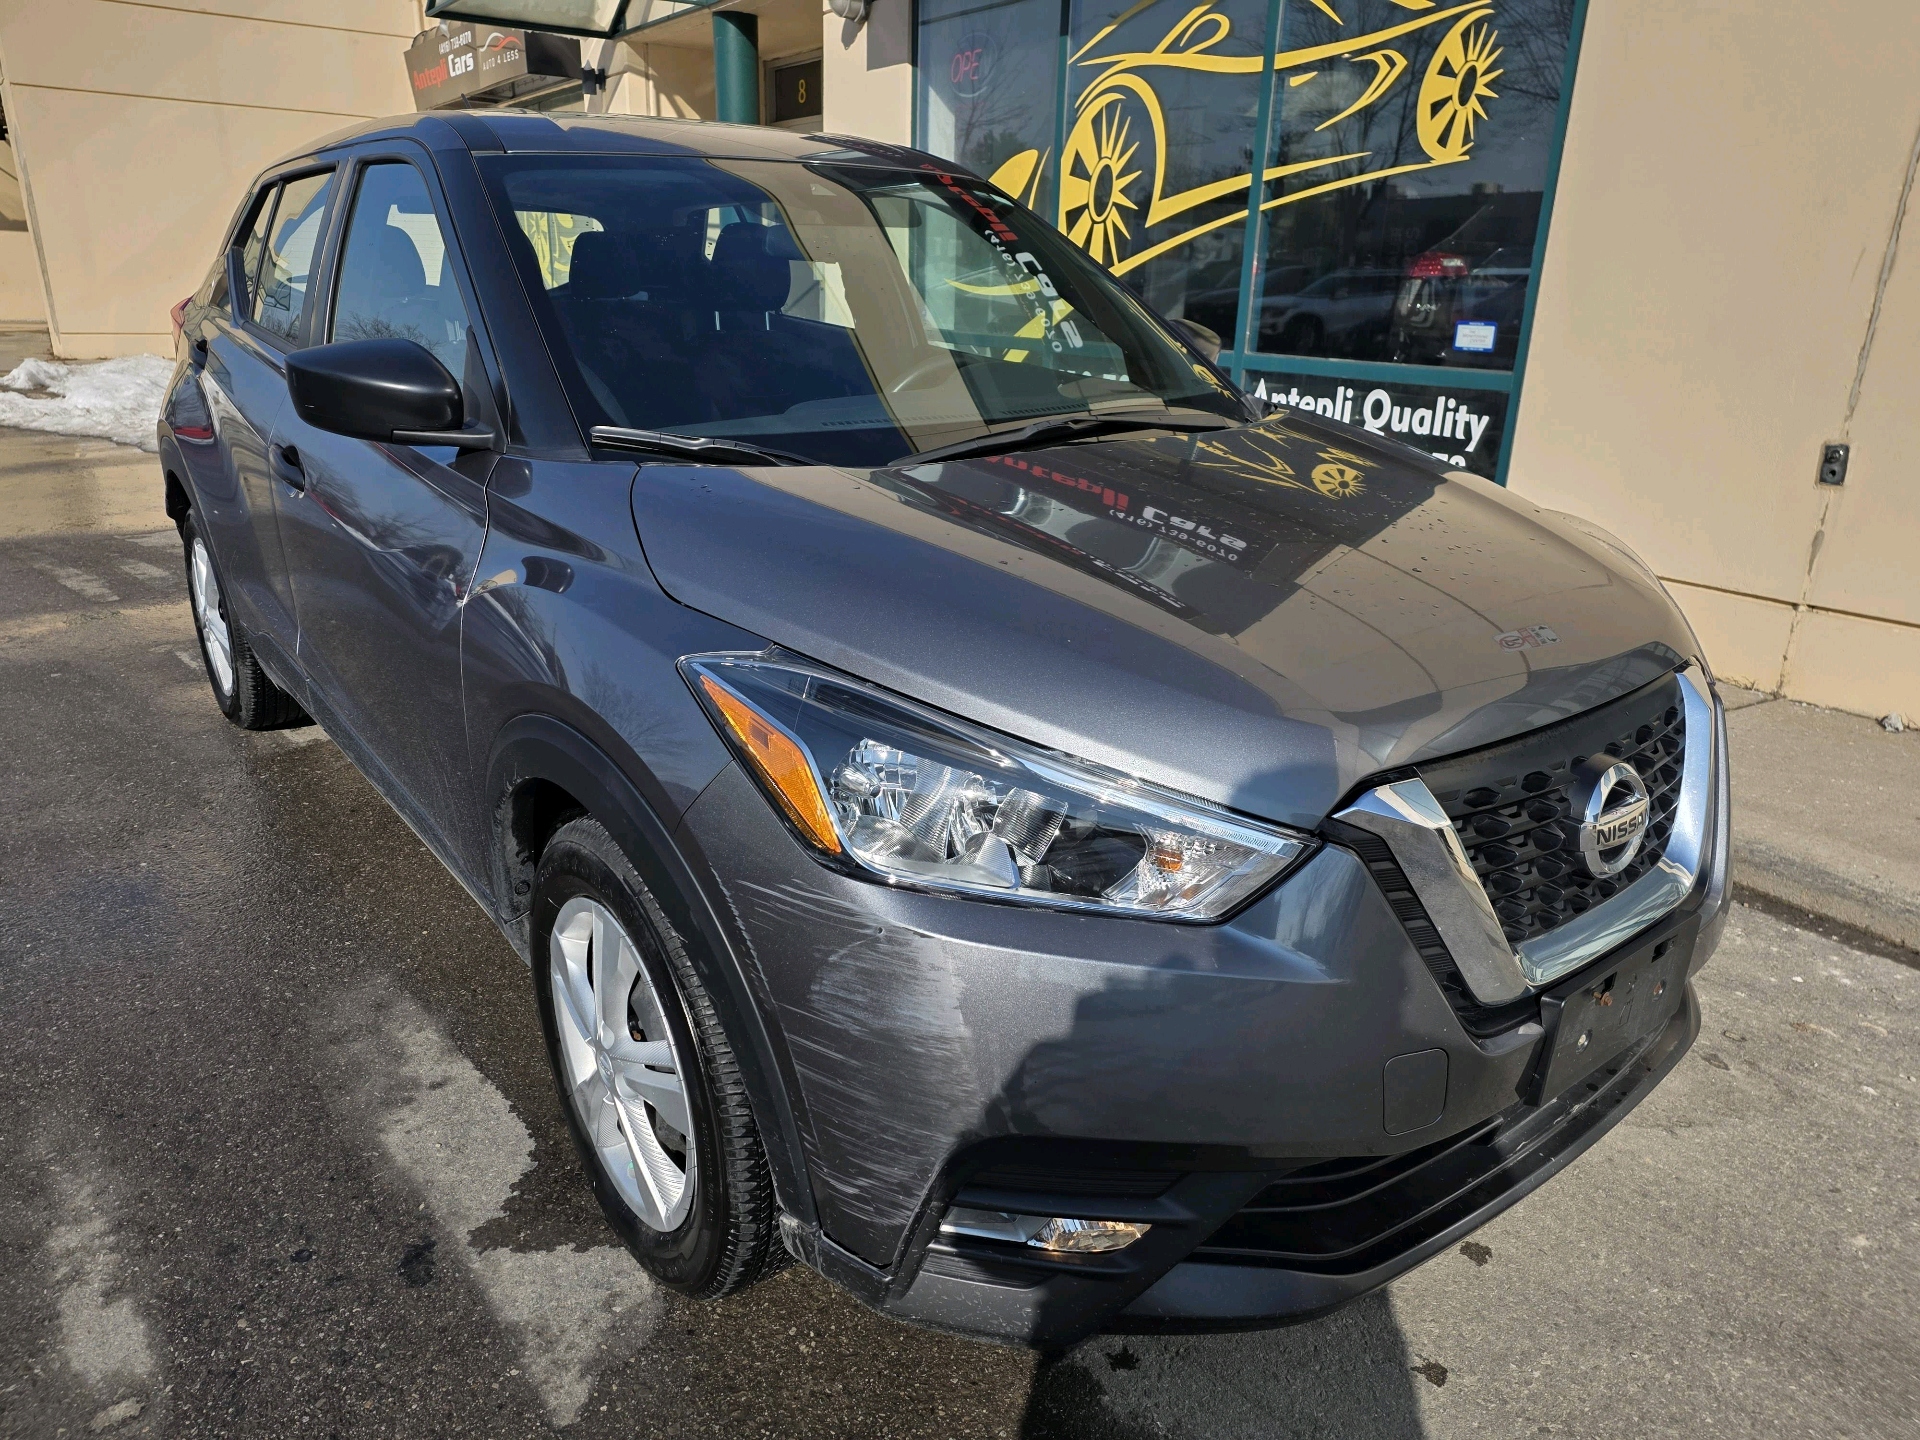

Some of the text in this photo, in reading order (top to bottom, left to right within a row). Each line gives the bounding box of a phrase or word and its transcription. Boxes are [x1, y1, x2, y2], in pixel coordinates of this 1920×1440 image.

[413, 52, 474, 91] Antepli Cars
[483, 57, 495, 71] AUTO
[503, 49, 519, 63] LESS
[951, 48, 984, 83] OPE
[798, 80, 806, 104] 8
[1362, 388, 1490, 452] Quality
